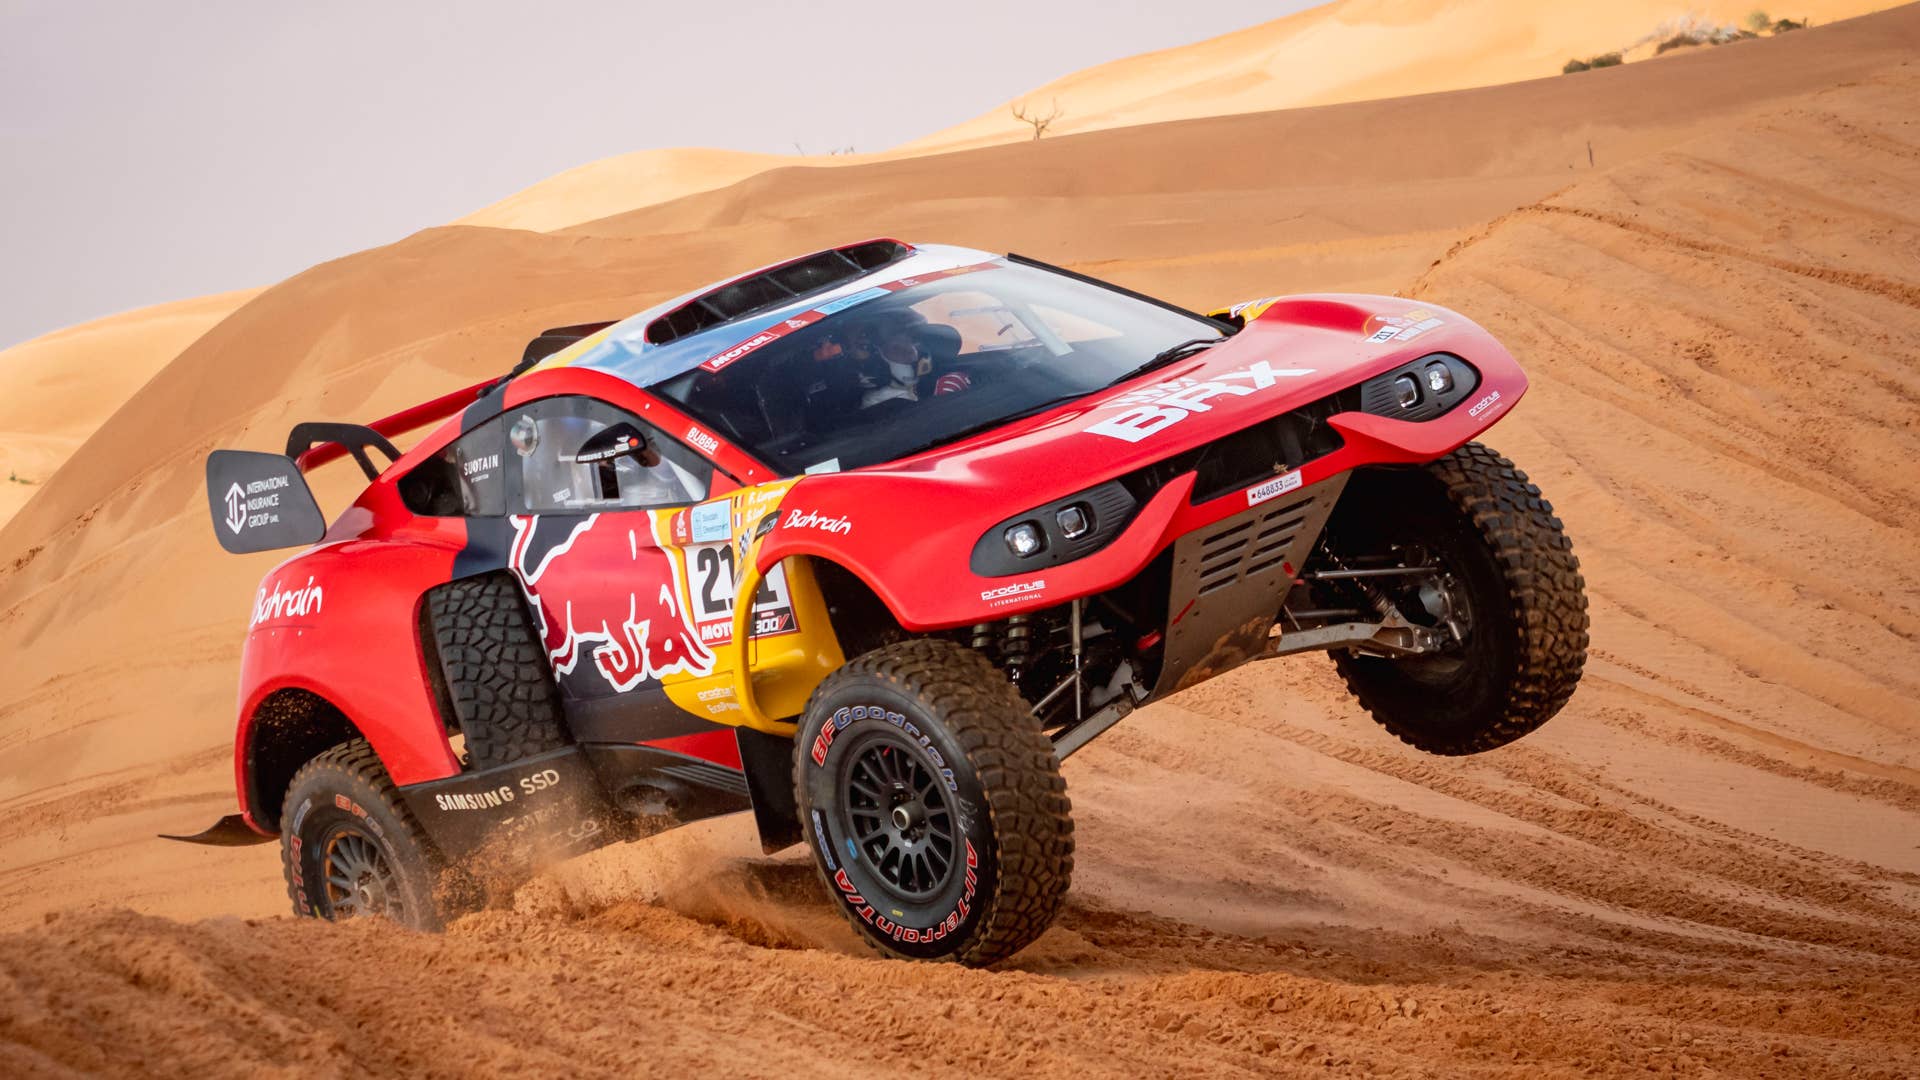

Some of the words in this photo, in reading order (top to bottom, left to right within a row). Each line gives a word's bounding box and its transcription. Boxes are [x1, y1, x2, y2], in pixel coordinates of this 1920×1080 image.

[711, 333, 772, 367] MOTUL
[1083, 360, 1316, 443] BRX
[1468, 390, 1501, 417] prodrive
[246, 475, 289, 494] INTERNATIONAL
[1257, 480, 1283, 498] 648833
[247, 493, 280, 511] INSURANCE
[248, 513, 269, 528] GROUP
[782, 508, 852, 535] Bahrain
[249, 575, 323, 628] Bahrain
[981, 580, 1046, 601] prodrive
[701, 623, 733, 641] MOT
[756, 613, 790, 634] 300V
[811, 705, 958, 791] BFGoodrich
[435, 785, 515, 811] SAMSUNG
[519, 769, 560, 795] SSD
